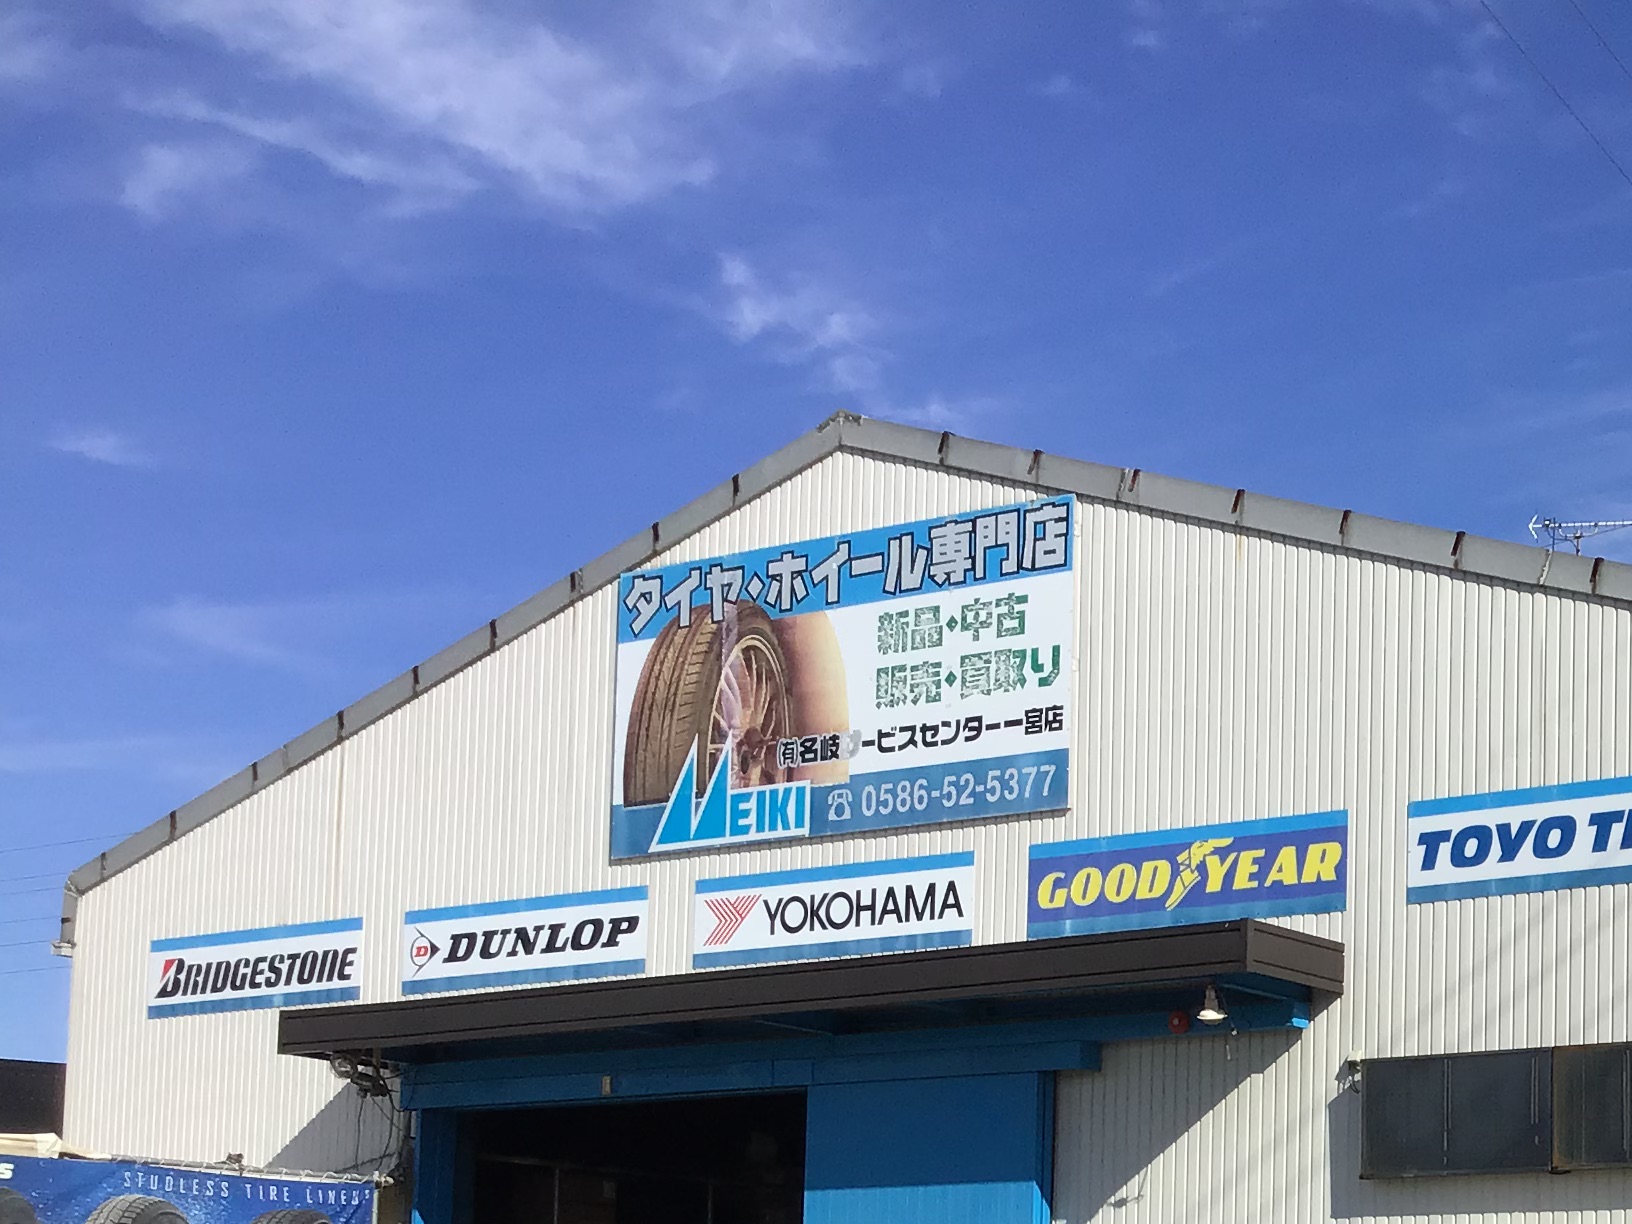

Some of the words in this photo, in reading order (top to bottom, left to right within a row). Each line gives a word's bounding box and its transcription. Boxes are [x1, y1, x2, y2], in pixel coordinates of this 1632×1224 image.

[623, 501, 1071, 637] タイヤ・ホイール専門店
[876, 592, 1029, 656] 新品・中古
[861, 764, 1057, 817] 0586-52-5377
[1416, 815, 1577, 871] TOYO
[763, 880, 964, 937] YOKOHAMA
[442, 916, 641, 964] DUNLOP
[155, 946, 358, 999] BRIDGESTONE
[124, 1171, 229, 1197] STUDLESS
[245, 1184, 290, 1202] TIRE
